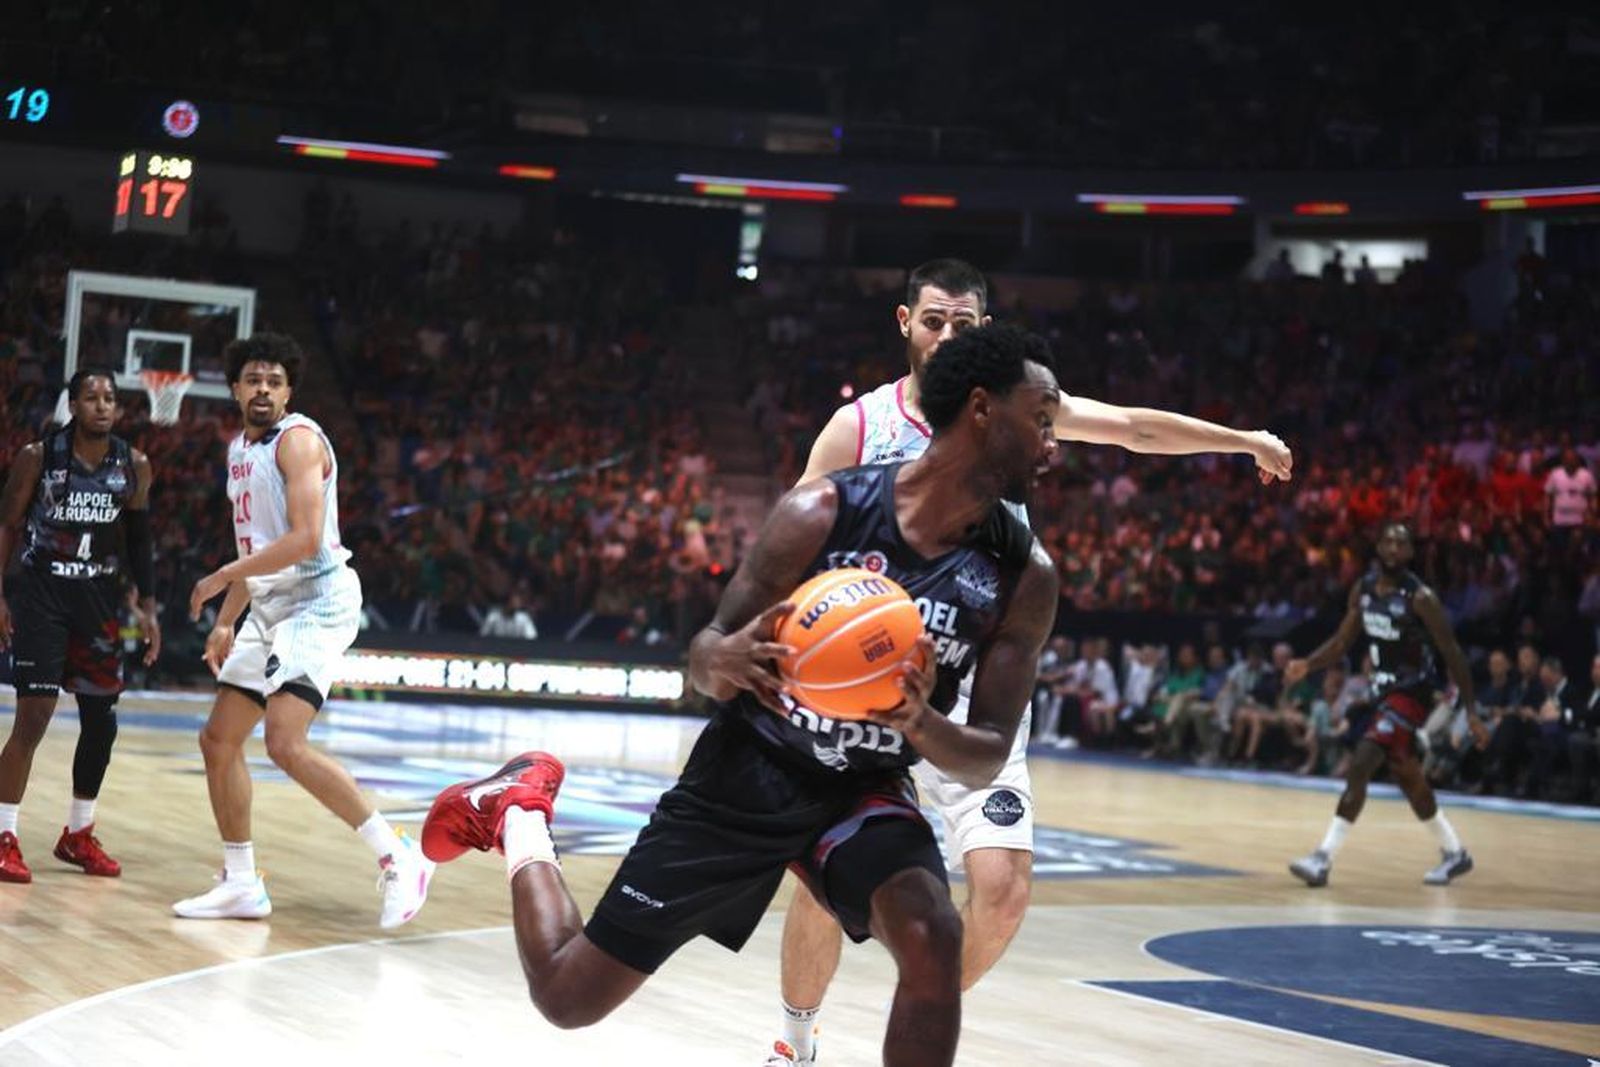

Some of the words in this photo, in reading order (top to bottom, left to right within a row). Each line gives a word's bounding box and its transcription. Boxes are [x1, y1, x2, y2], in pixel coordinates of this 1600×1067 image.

[6, 87, 50, 122] 19
[140, 179, 187, 218] 17
[77, 533, 92, 560] 4
